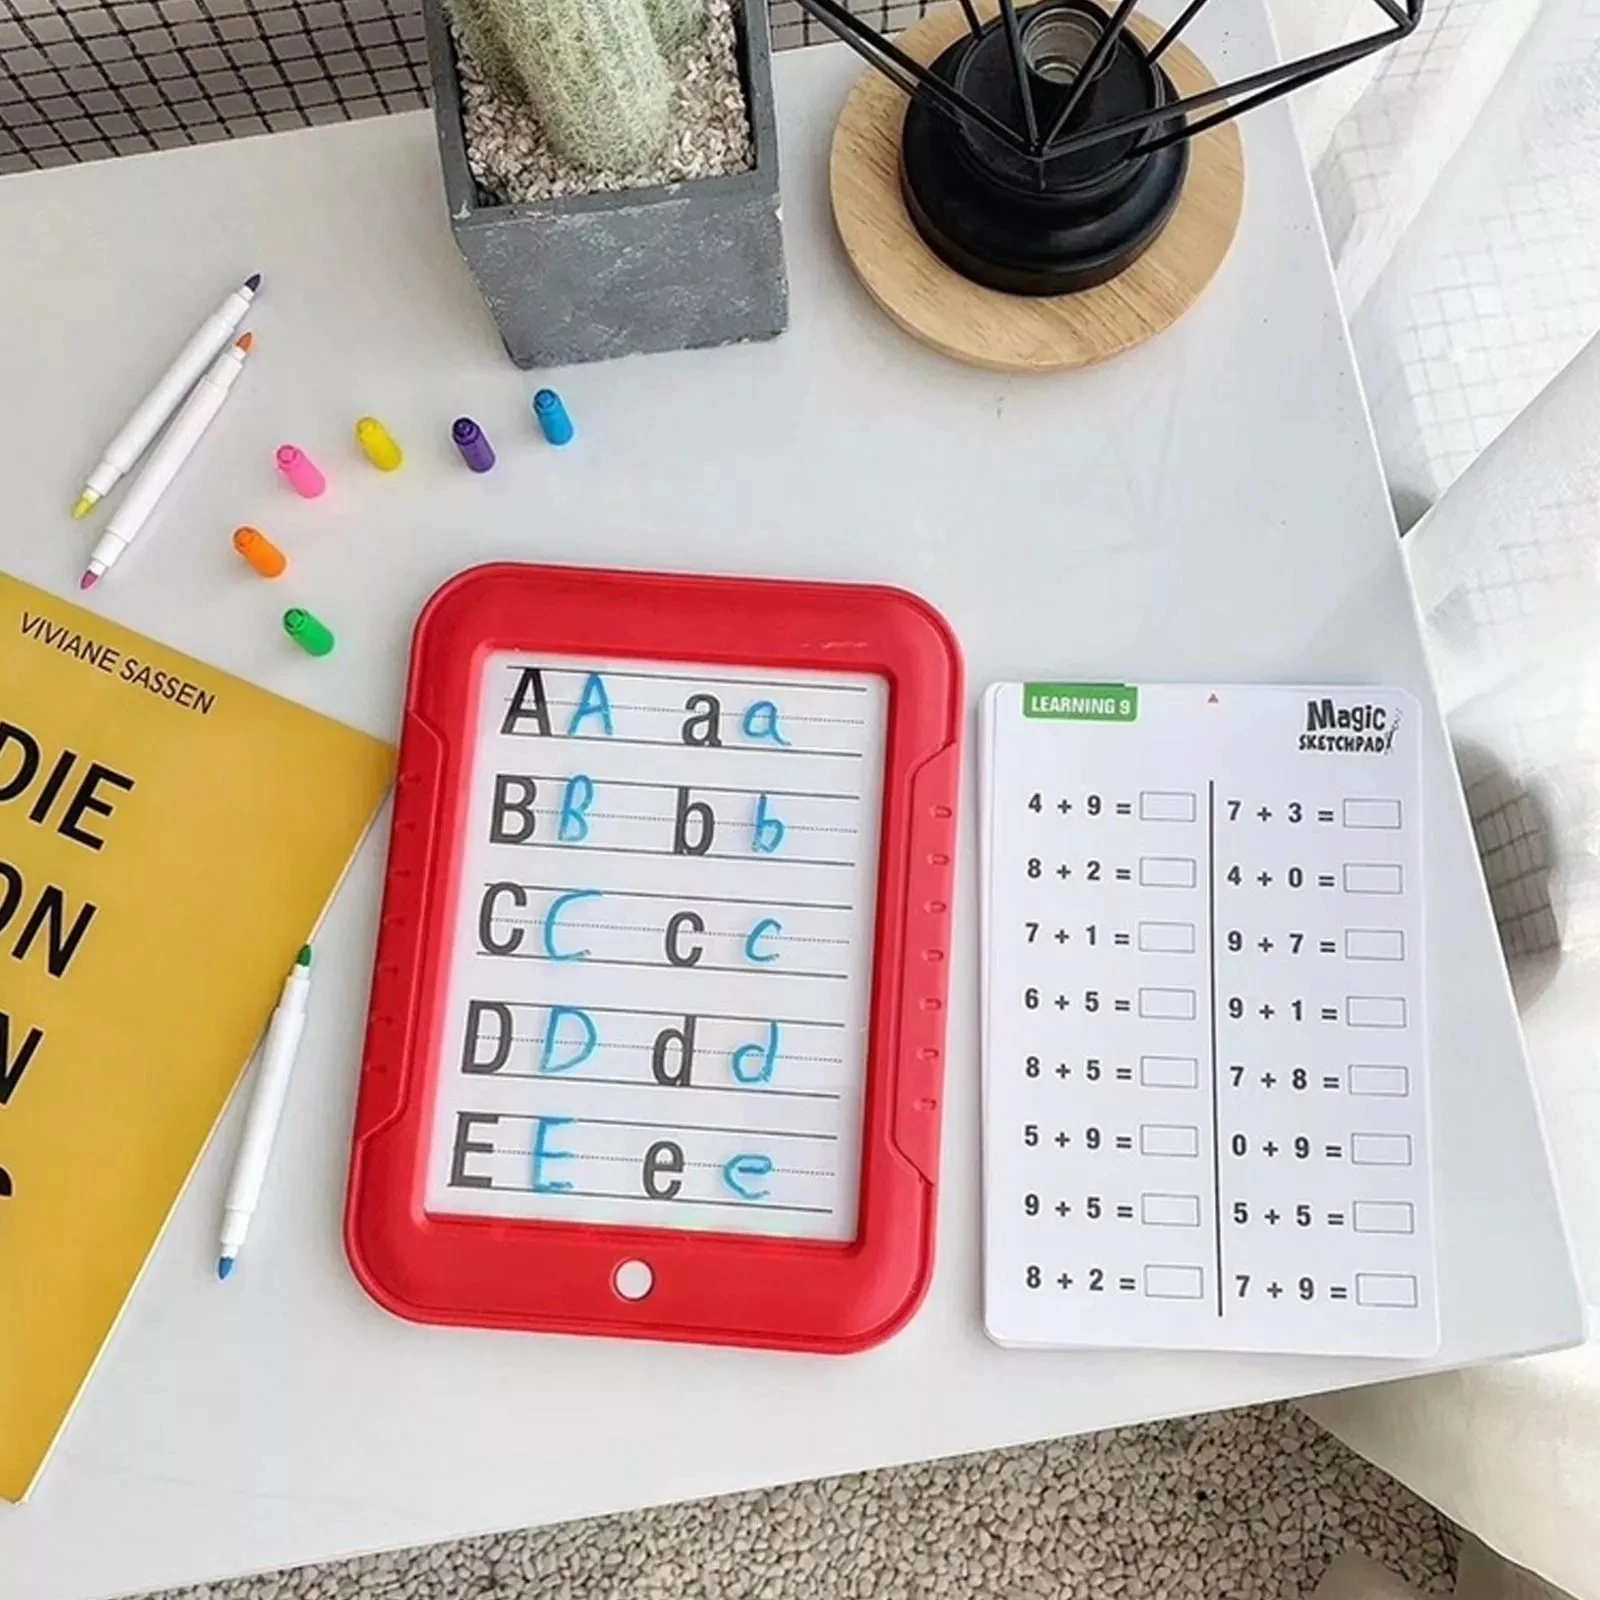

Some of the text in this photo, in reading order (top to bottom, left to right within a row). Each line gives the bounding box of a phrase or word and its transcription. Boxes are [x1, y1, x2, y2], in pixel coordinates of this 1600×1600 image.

[21, 611, 215, 715] VIVIANE SASSEN
[500, 667, 722, 747] A a
[567, 671, 791, 746] A a
[1031, 695, 1131, 715] LEARNING 9
[1306, 698, 1387, 732] Magic
[1299, 733, 1385, 753] SKETCHPAD
[489, 774, 714, 856] B b
[557, 774, 786, 853] B b
[1028, 793, 1131, 816] 4 + 9 =
[1227, 800, 1334, 824] 7 + 3 =
[1027, 858, 1131, 881] 8 + 2 =
[1227, 865, 1335, 888] 4 + 0 =
[478, 881, 704, 967] C c
[543, 888, 782, 963] C c
[1025, 922, 1130, 946] 7 + 1 =
[1227, 930, 1336, 954] 9 + 7 =
[1025, 988, 1130, 1013] 6 + 5 =
[1228, 997, 1338, 1021] 9 + 1 =
[461, 1000, 696, 1087] D d
[540, 1005, 781, 1084] D d
[1025, 1056, 1132, 1081] 8 + 5 =
[1229, 1066, 1340, 1090] 7 + 8 =
[1024, 1124, 1132, 1150] 5 + 9 =
[1232, 1134, 1342, 1159] 0 + 9 =
[449, 1111, 684, 1200] E e
[531, 1115, 774, 1200] E e
[1024, 1193, 1133, 1219] 9 + 5 =
[1234, 1202, 1344, 1227] 5 + 5 =
[1026, 1265, 1136, 1291] 8 + 2 =
[1235, 1274, 1347, 1301] 7 + 9 =
